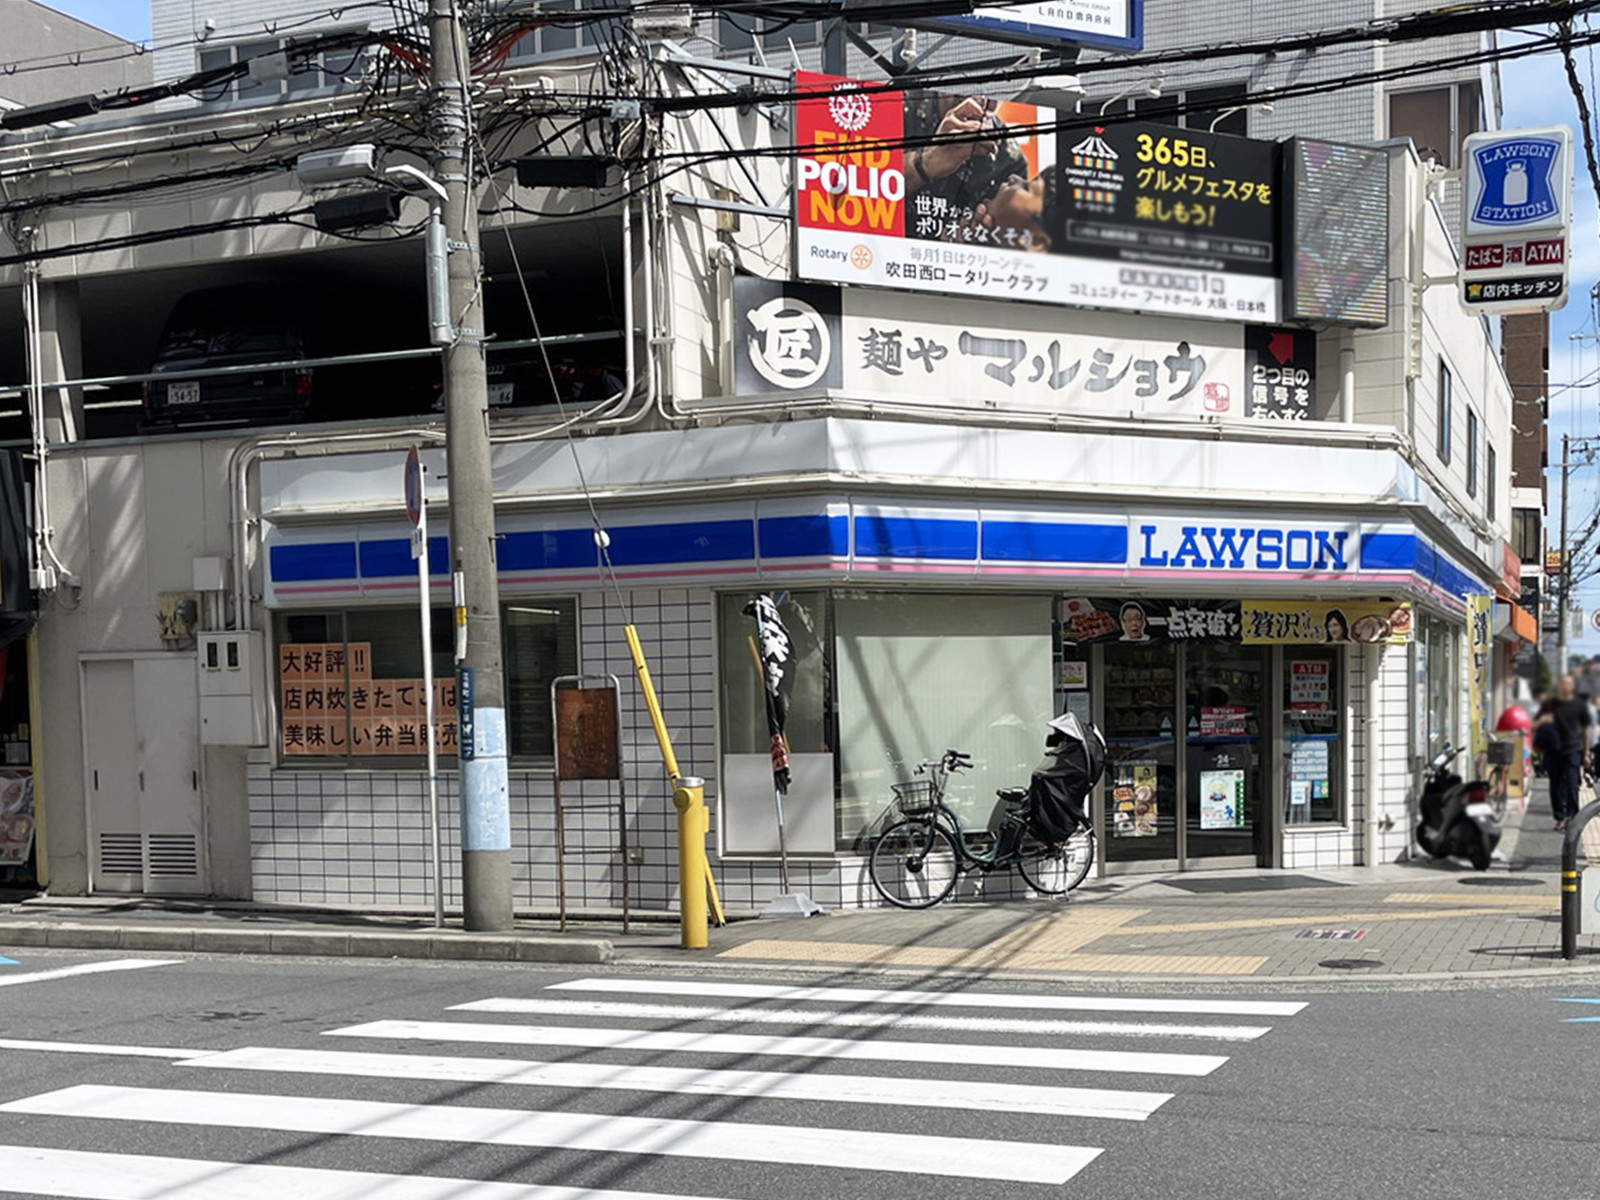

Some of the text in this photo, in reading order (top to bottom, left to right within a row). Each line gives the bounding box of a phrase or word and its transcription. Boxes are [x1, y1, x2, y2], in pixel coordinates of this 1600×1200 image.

[1038, 6, 1112, 26] LANDMARK
[812, 129, 892, 170] END
[1482, 145, 1551, 164] LAWSON
[797, 156, 905, 203] POLIO
[1136, 166, 1272, 205] グルメフェスタを
[810, 190, 898, 230] NOW
[914, 195, 973, 221] 世界から
[1481, 201, 1548, 219] STATION
[915, 218, 1034, 249] ポリオをなくそう
[810, 245, 849, 263] Rotary
[1467, 248, 1502, 267] たばこ
[1527, 245, 1562, 262] ATM
[885, 261, 1050, 294] 吹田西ロータリークラブ
[1483, 280, 1561, 299] 店内キッチン
[858, 327, 949, 377] 麺や
[958, 326, 1207, 403] マルショウ
[1252, 364, 1310, 387] 2つ目の
[1252, 384, 1309, 406] 信号を
[1140, 524, 1349, 571] LAWSON
